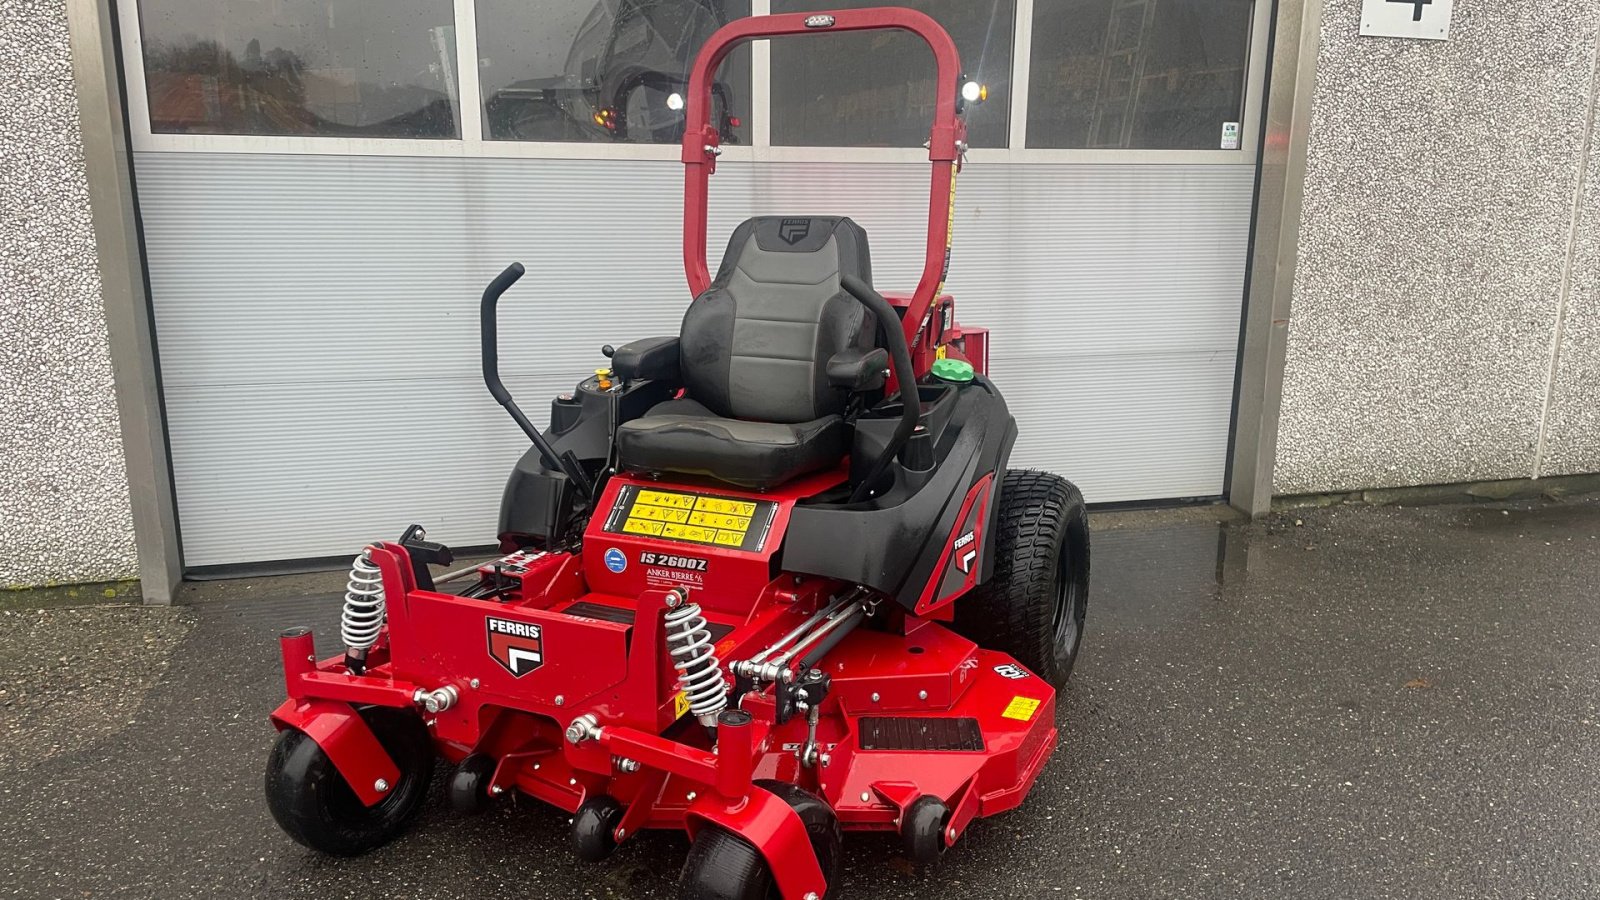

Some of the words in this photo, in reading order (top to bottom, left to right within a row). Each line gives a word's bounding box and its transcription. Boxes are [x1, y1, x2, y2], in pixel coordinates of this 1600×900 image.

[954, 531, 974, 550] FERRIS
[640, 552, 656, 564] IS
[657, 555, 707, 571] 2600Z
[646, 568, 670, 578] ANKER
[671, 571, 694, 581] BJERRE
[489, 619, 540, 638] FERRIS
